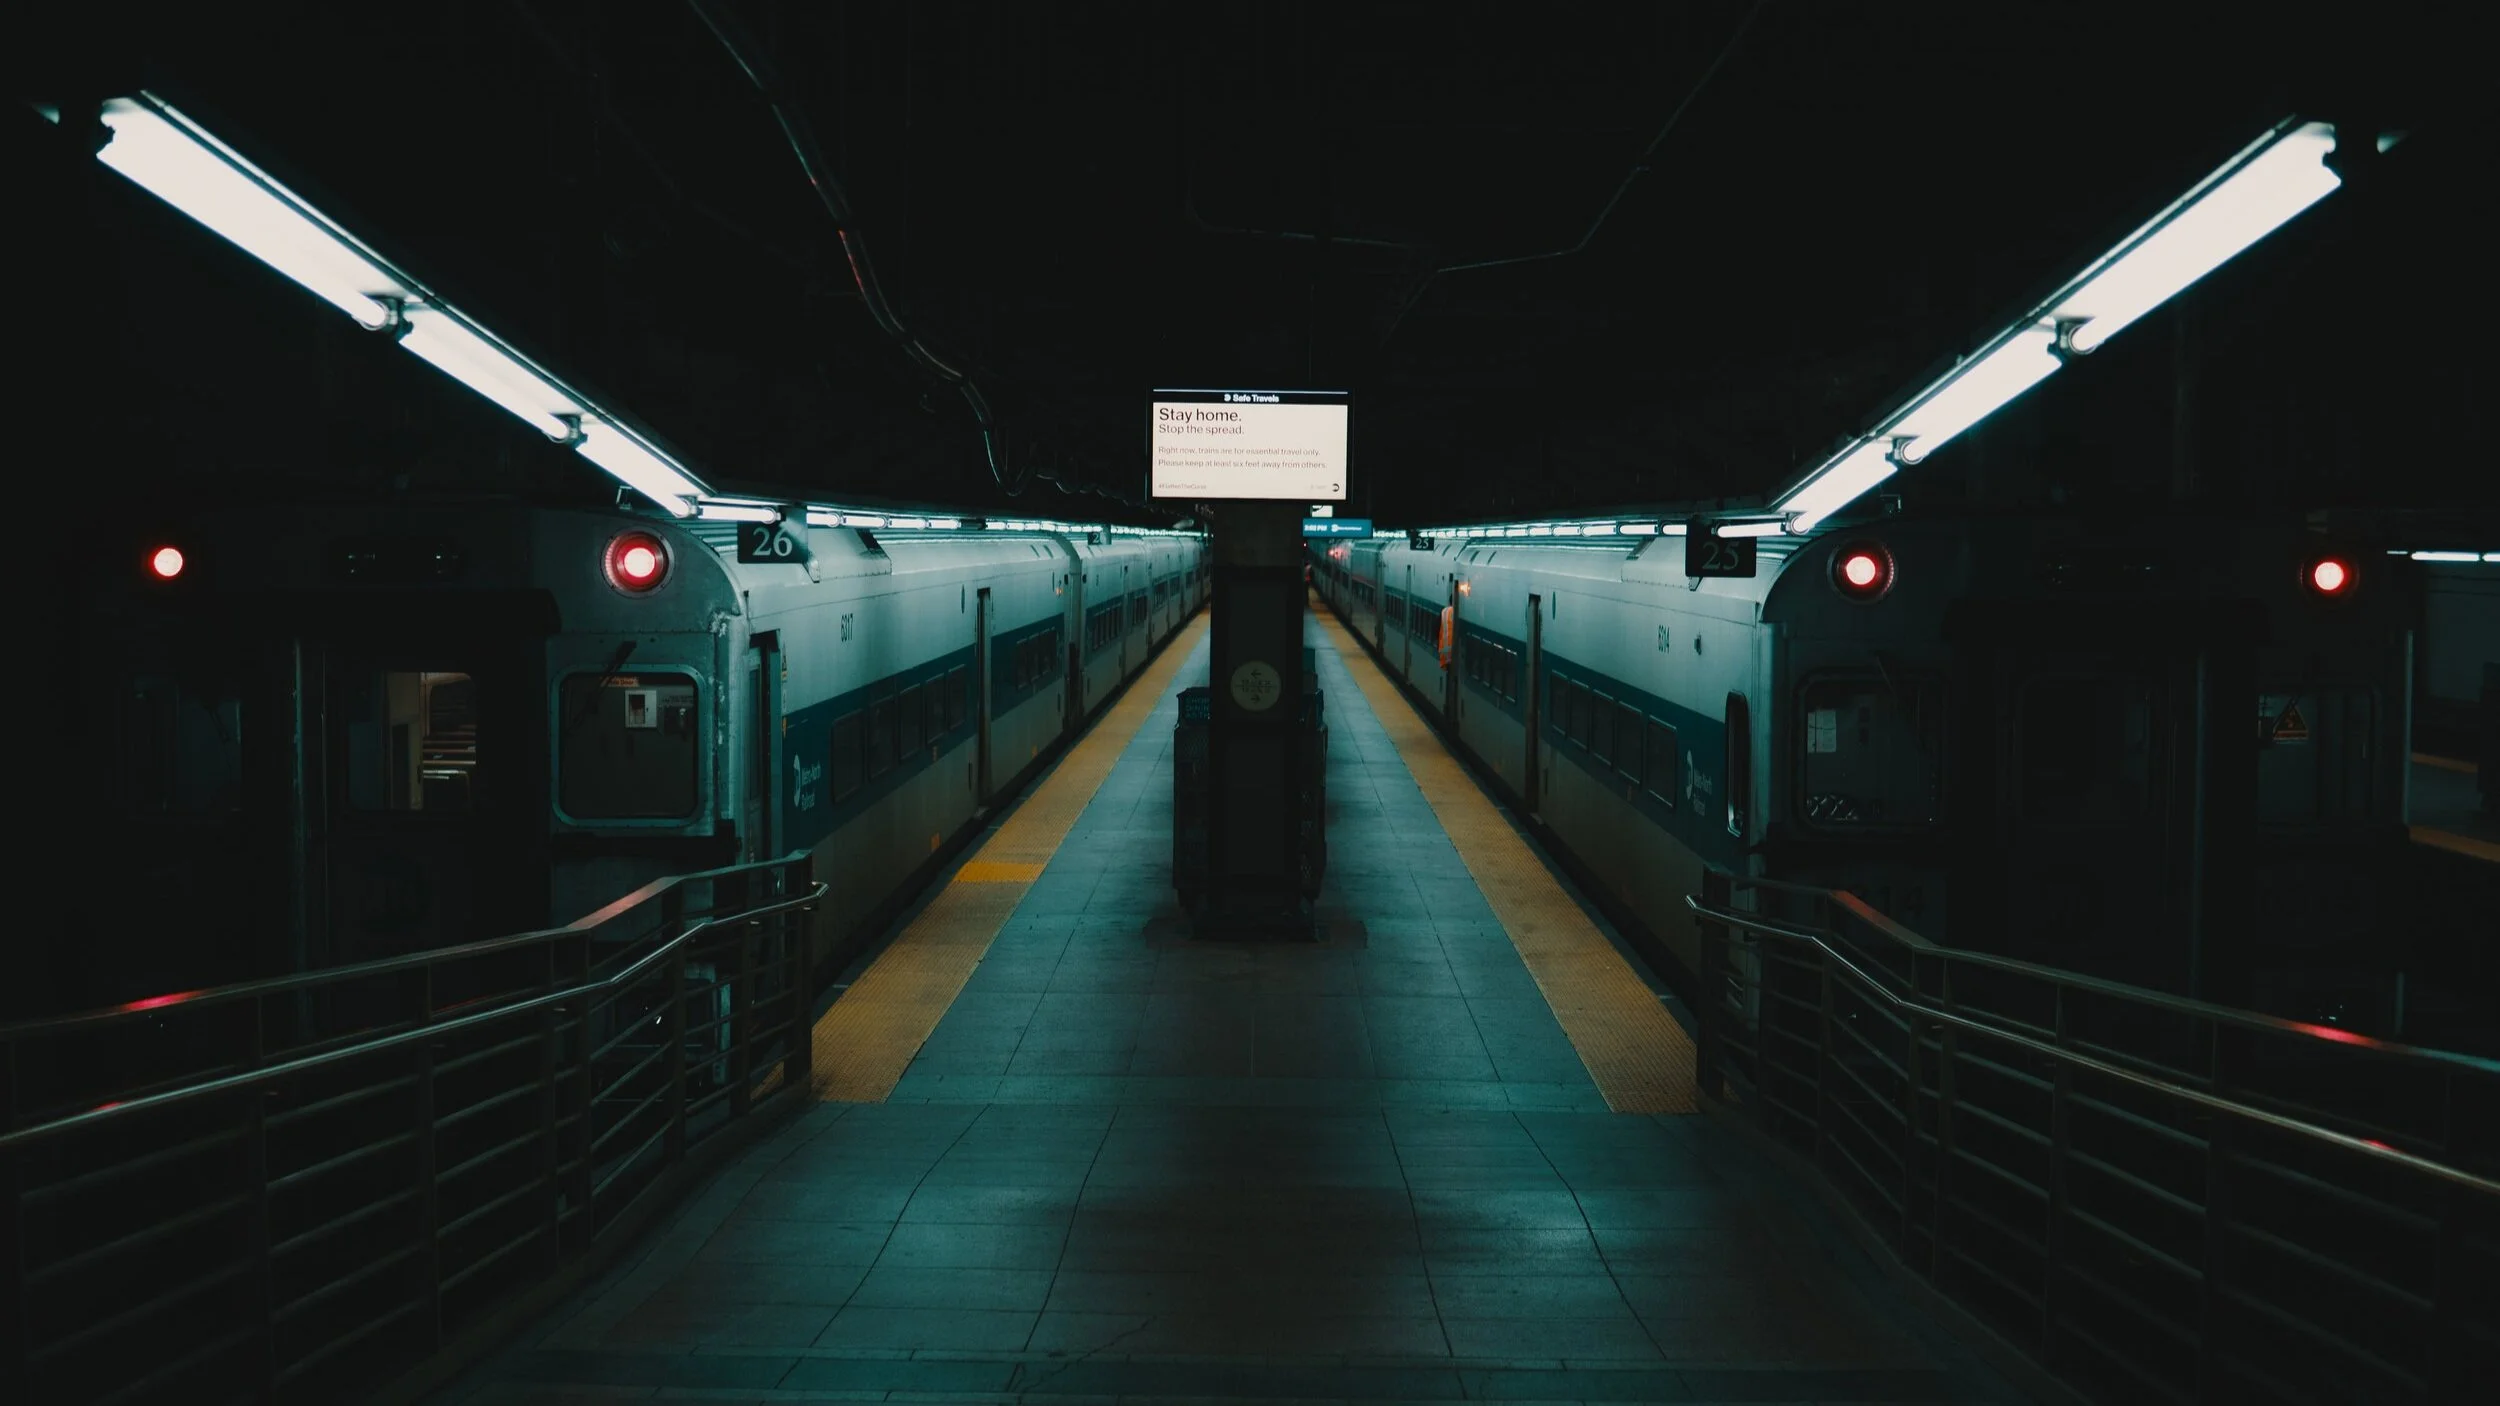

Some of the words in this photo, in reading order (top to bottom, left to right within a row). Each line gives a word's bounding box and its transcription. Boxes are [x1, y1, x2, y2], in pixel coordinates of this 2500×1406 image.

[1232, 393, 1251, 403] Safe
[1251, 394, 1280, 403] Travels
[1159, 407, 1192, 423] Stay
[1196, 408, 1242, 422] home.
[1158, 423, 1184, 435] Stop
[1186, 424, 1203, 434] the
[1205, 425, 1245, 435] spread.
[1158, 446, 1179, 455] Right
[1198, 447, 1220, 455] trains
[1303, 449, 1321, 457] only.
[1158, 459, 1184, 467] Please
[1185, 460, 1204, 468] keep
[1233, 460, 1243, 468] six
[1245, 460, 1260, 468] feet
[1261, 461, 1281, 469] away
[1301, 461, 1327, 469] others.
[751, 525, 794, 557] 26
[1415, 537, 1429, 549] 25
[1701, 540, 1741, 571] 25
